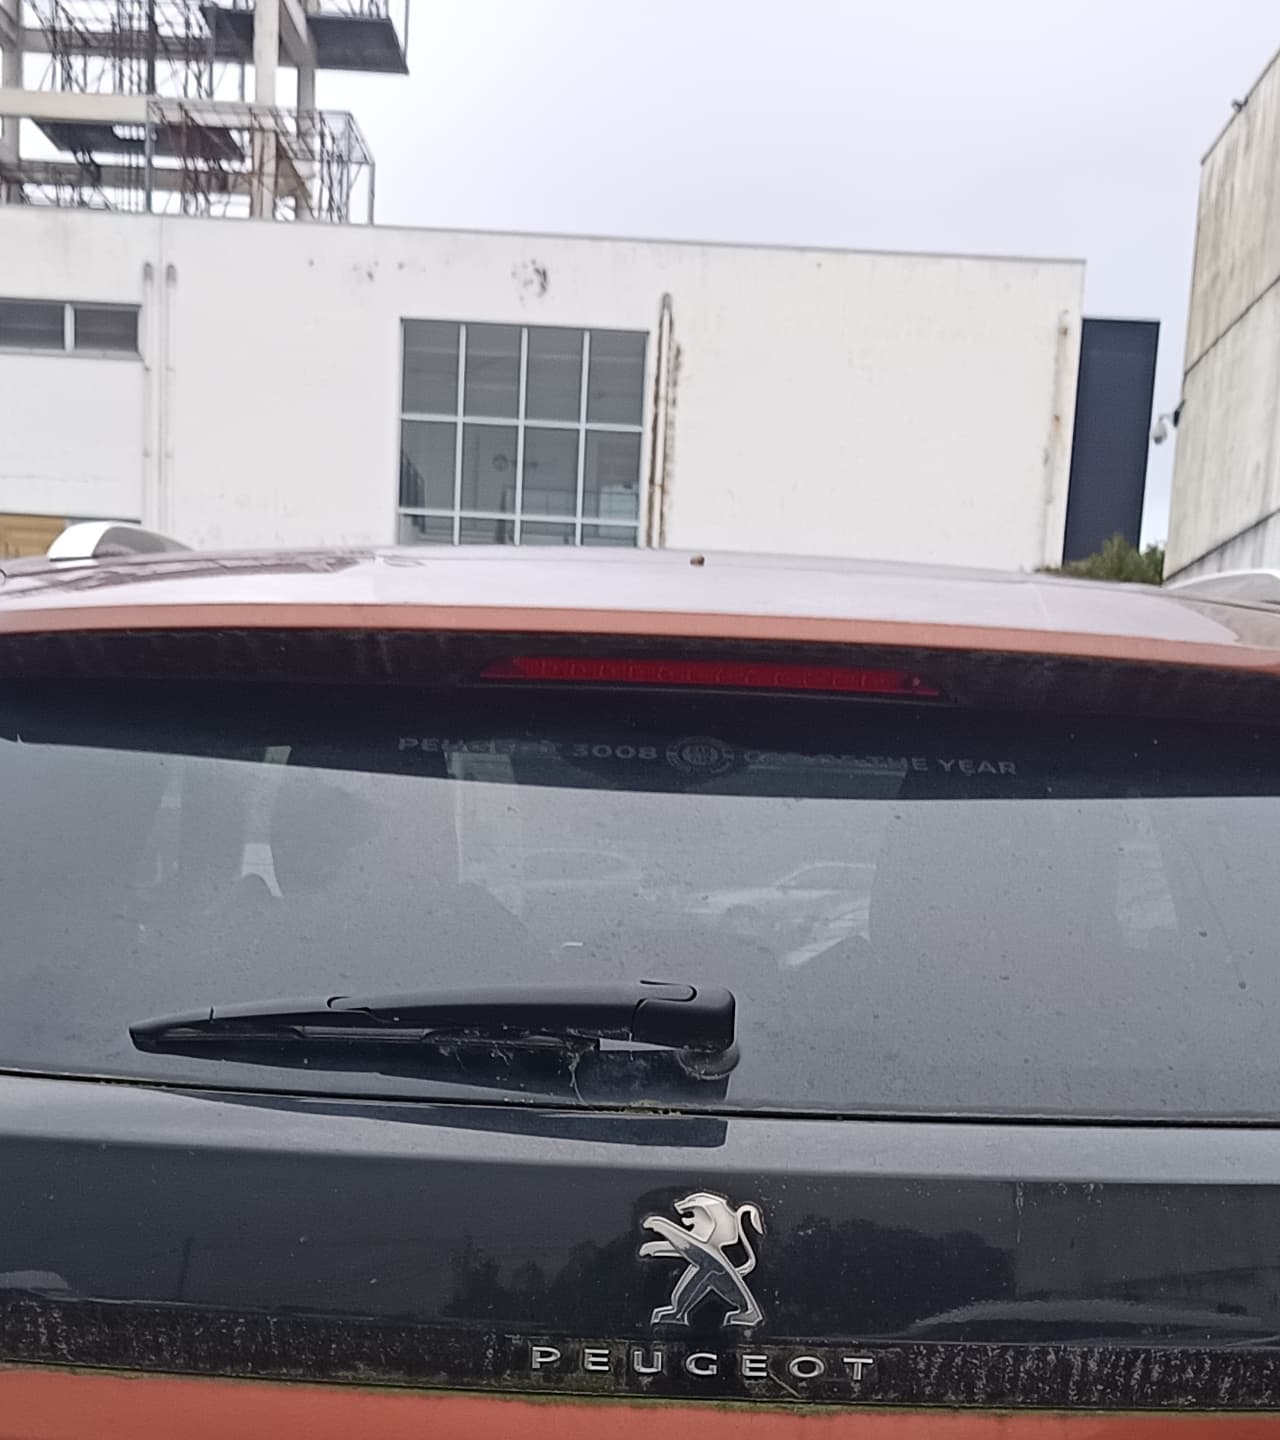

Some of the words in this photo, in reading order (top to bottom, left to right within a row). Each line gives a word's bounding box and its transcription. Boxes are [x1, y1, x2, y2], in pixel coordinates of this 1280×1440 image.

[572, 743, 657, 760] 3008
[937, 758, 1017, 776] YEAR
[531, 1346, 874, 1381] PEUGEOT
